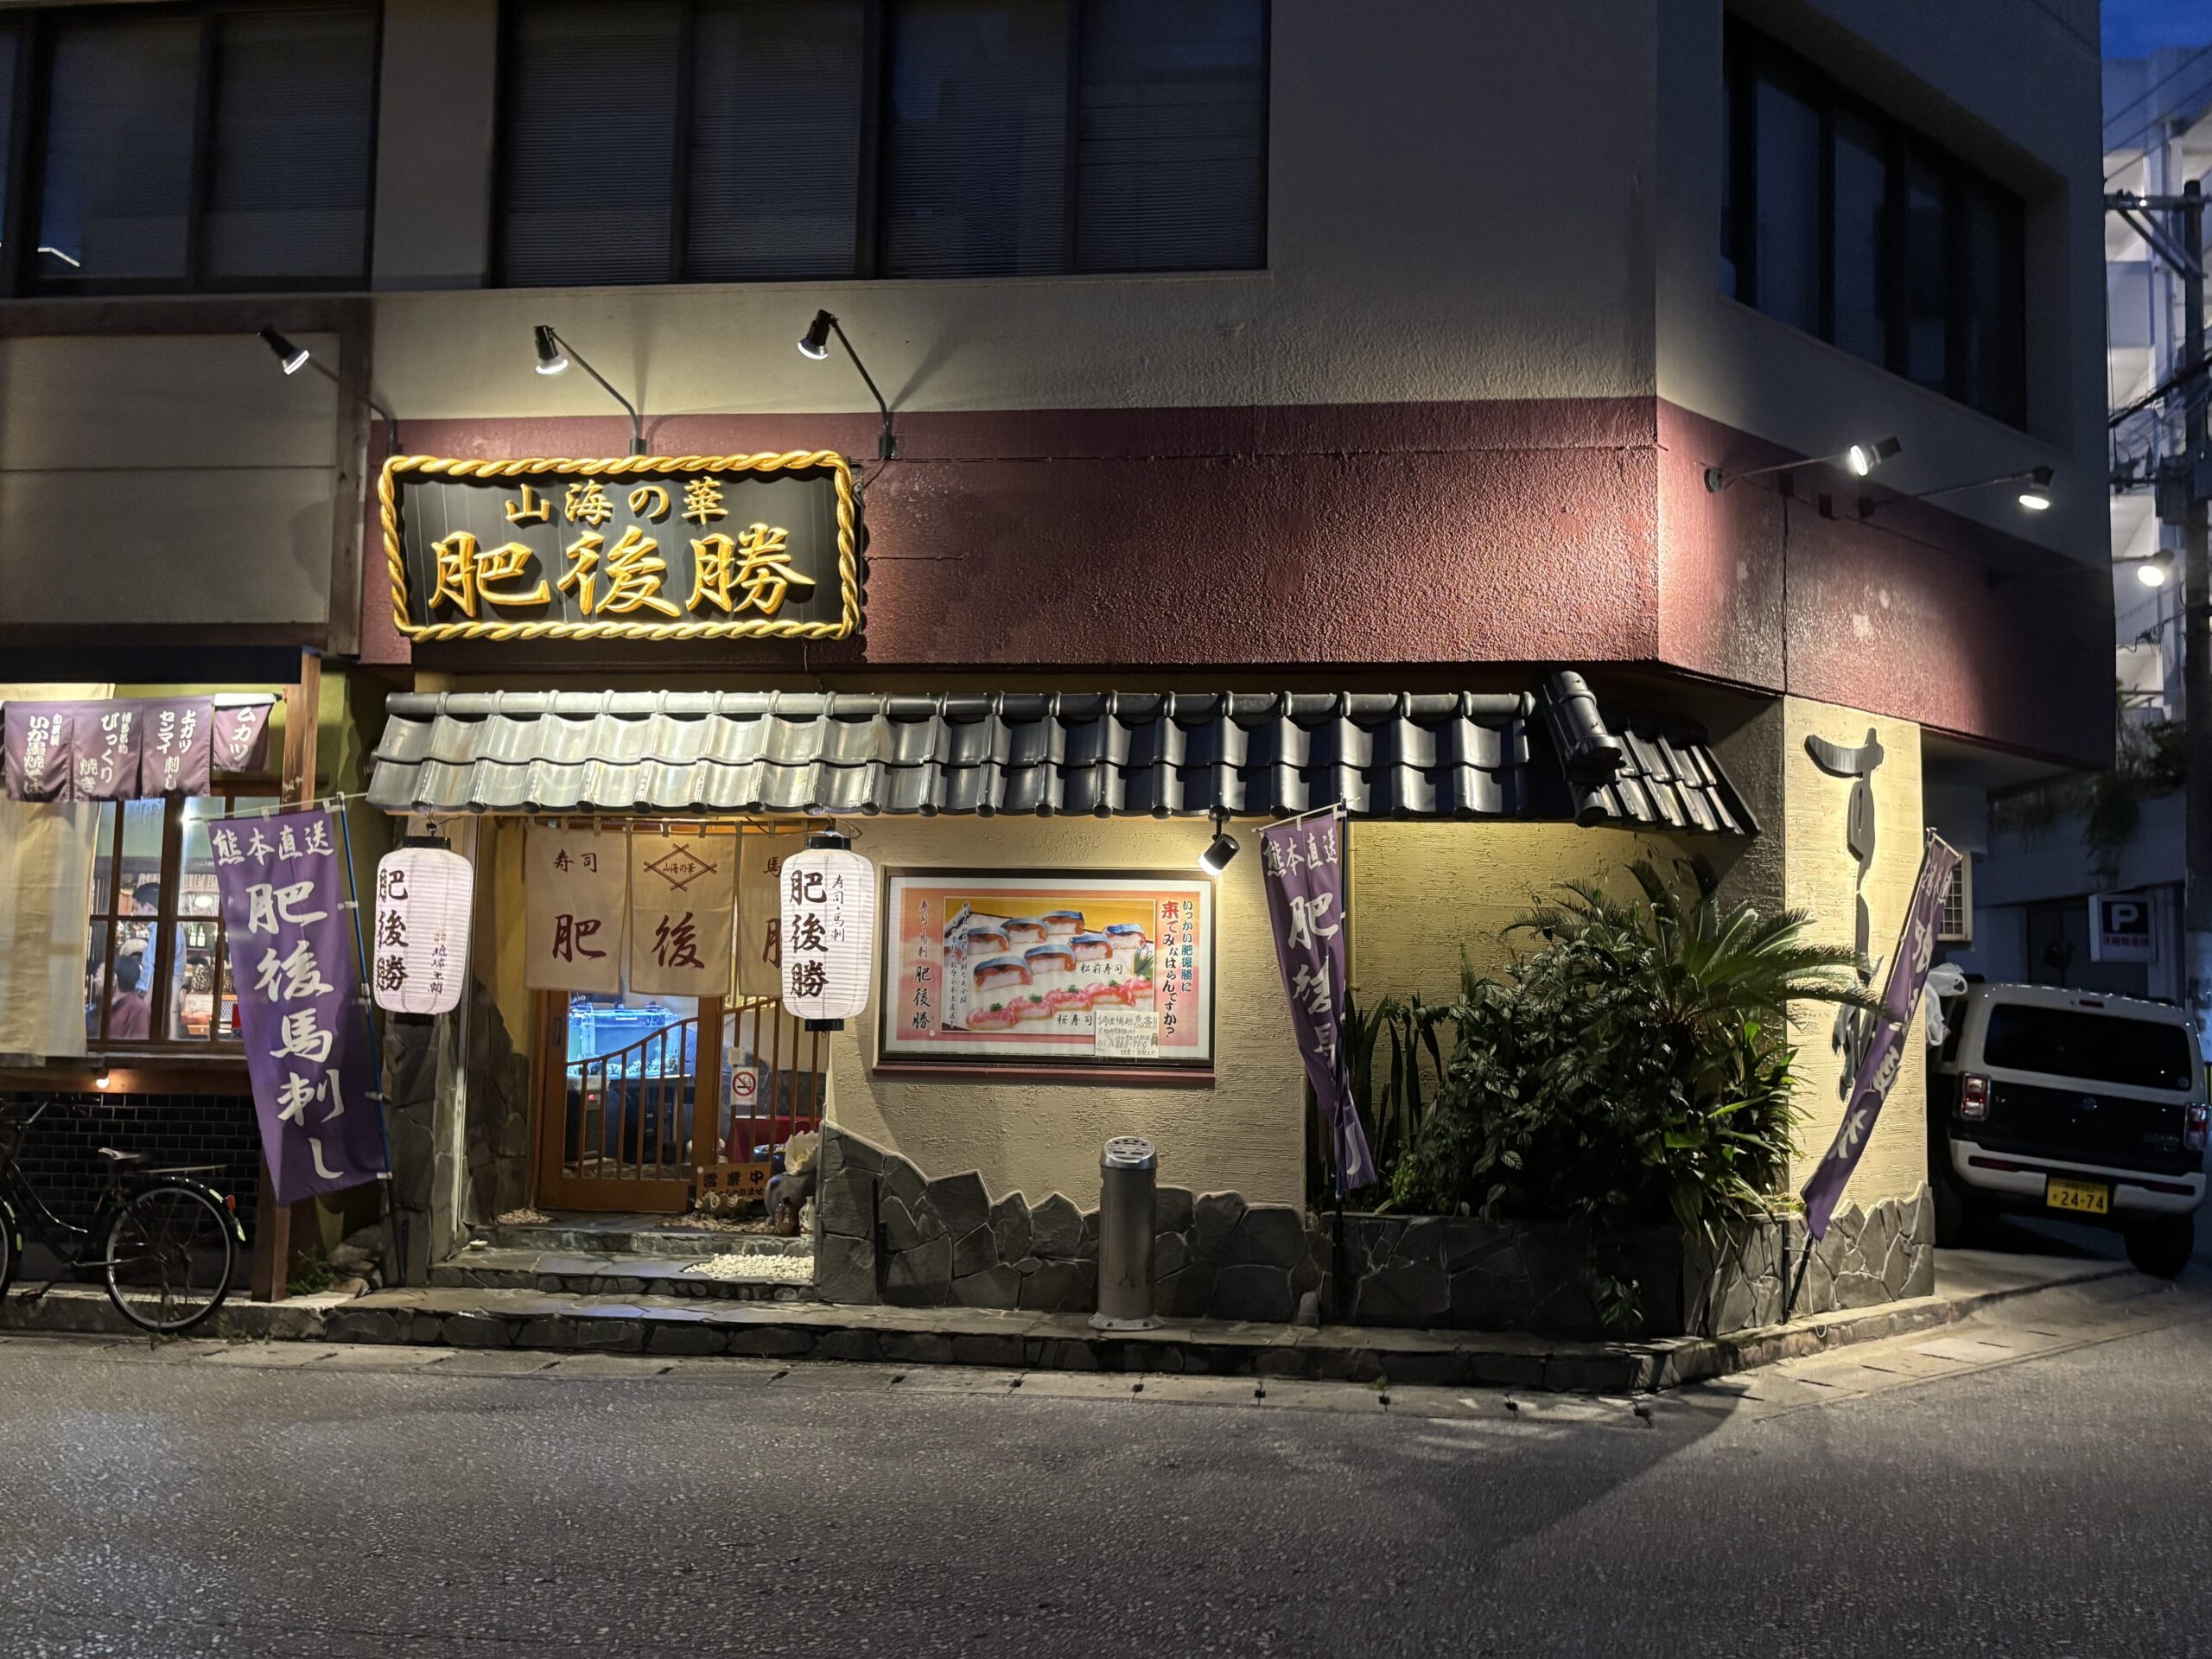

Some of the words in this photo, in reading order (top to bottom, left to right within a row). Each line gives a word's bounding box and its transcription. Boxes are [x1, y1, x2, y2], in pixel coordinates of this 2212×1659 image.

[505, 476, 729, 524] 山海の華
[429, 523, 816, 617] 肥後勝
[101, 712, 120, 784] びっくり
[156, 710, 175, 754] センマイ
[164, 756, 180, 791] 刺し
[213, 825, 335, 867] 熊本直送
[554, 849, 599, 874] 寿司
[1264, 827, 1338, 878] 熊本直送
[377, 868, 410, 992] 肥後勝
[790, 869, 830, 998] 肥後勝
[2111, 903, 2139, 931] P
[1080, 963, 1122, 975] 松前寿司
[1181, 900, 1193, 992] いっかい肥後勝に
[912, 965, 931, 1029] 肥後勝
[247, 882, 346, 1179] 肥後馬刺し
[703, 1170, 764, 1187] 営業中
[2060, 1191, 2104, 1210] 24-74
